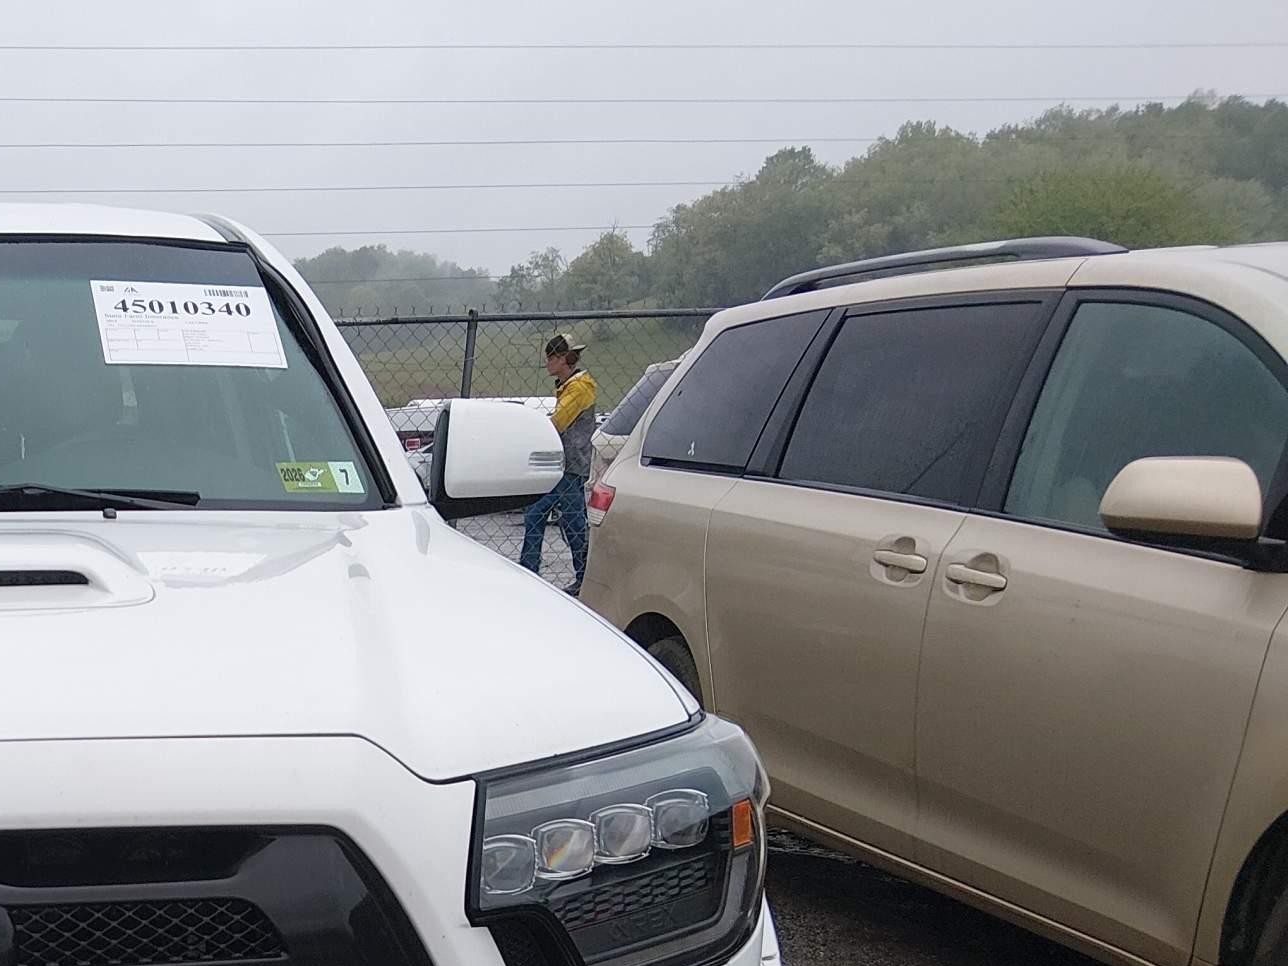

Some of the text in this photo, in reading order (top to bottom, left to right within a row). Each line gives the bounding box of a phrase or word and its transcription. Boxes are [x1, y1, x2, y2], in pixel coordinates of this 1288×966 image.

[113, 299, 251, 317] 45010340
[280, 468, 306, 482] 2026
[339, 469, 350, 486] 7
